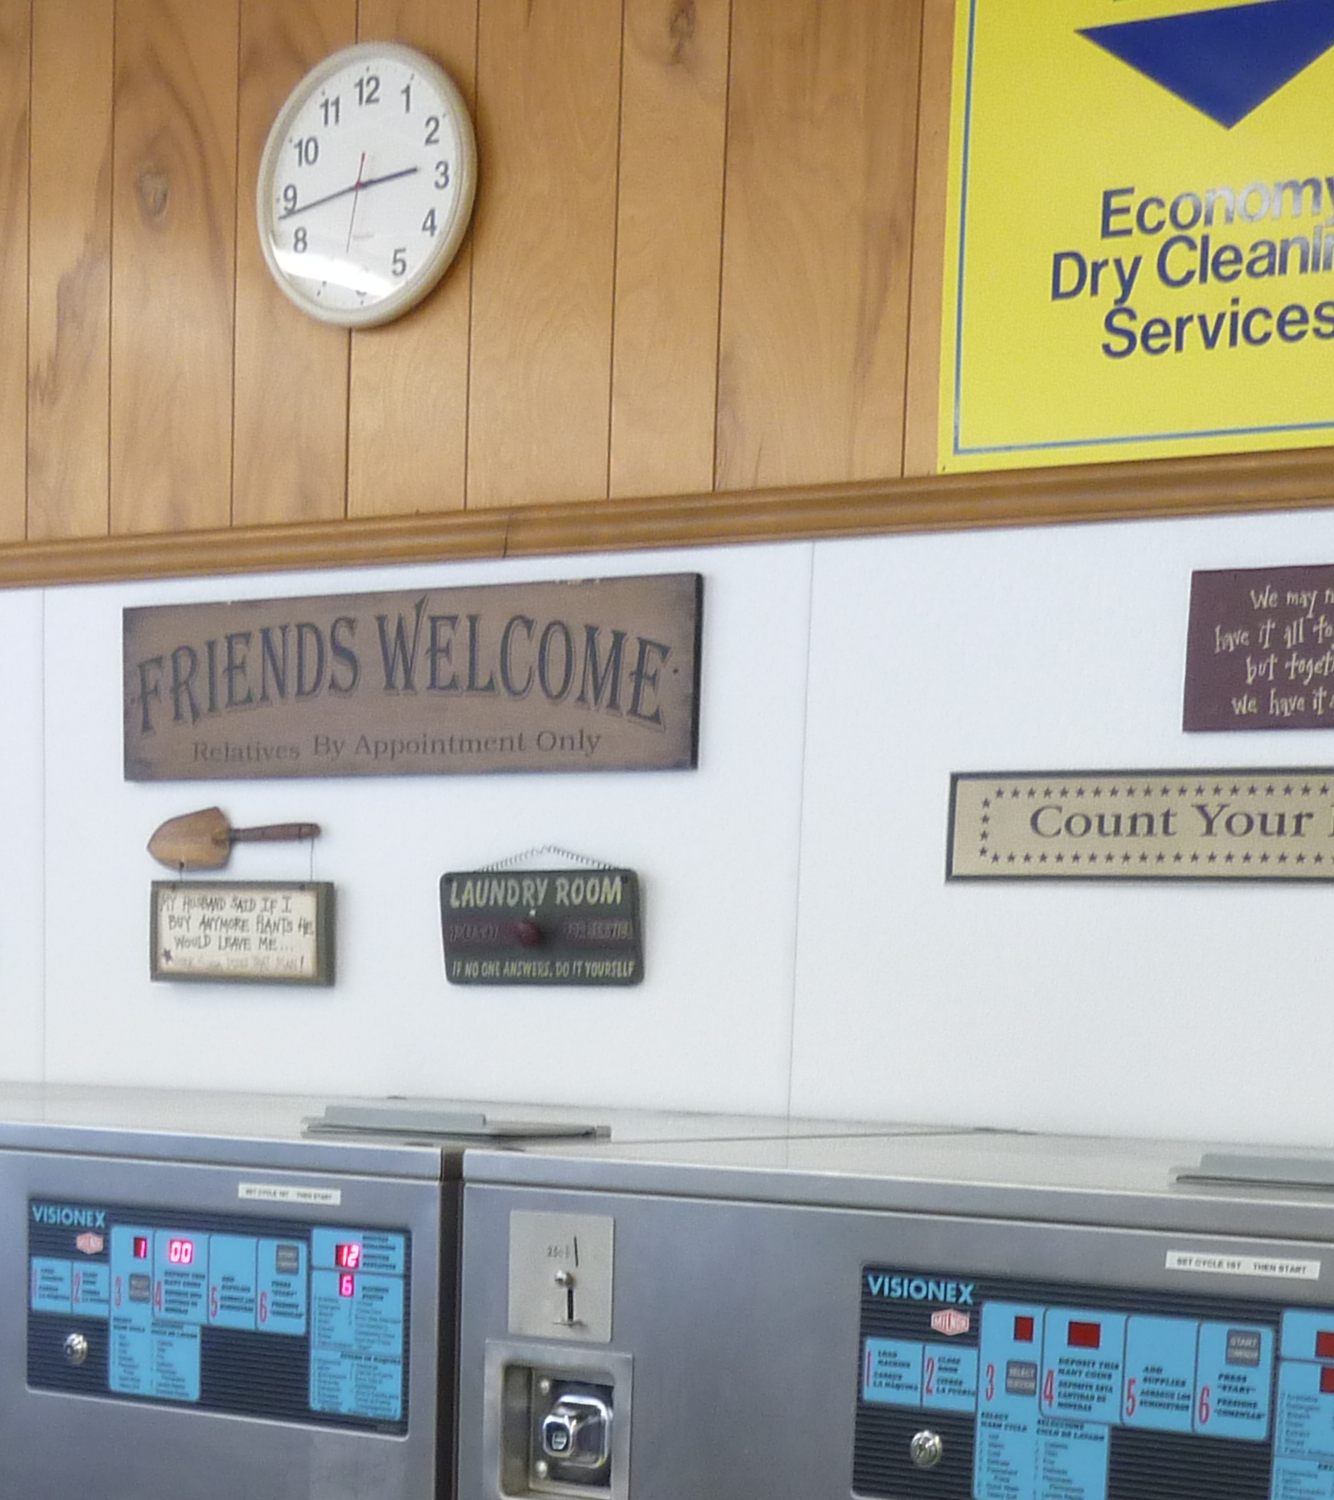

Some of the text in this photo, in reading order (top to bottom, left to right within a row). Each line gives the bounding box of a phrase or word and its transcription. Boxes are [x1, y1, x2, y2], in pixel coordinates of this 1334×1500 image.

[354, 75, 381, 106] 12
[401, 84, 411, 113] 1
[320, 96, 340, 127] 11
[425, 116, 440, 145] 2
[294, 136, 318, 167] 10
[434, 160, 450, 189] 3
[283, 184, 297, 214] 9
[422, 208, 437, 237] 4
[293, 226, 308, 253] 8
[392, 248, 407, 276] 5
[1051, 250, 1142, 306] Dry
[1250, 584, 1278, 609] We
[1287, 590, 1317, 619] may
[1214, 625, 1249, 654] have
[1258, 619, 1276, 650] it
[1284, 617, 1304, 649] all
[136, 595, 672, 734] FRIENDS WELCOME
[1246, 653, 1277, 685] but
[1269, 688, 1305, 717] have
[1313, 686, 1327, 715] it
[193, 729, 600, 764] Relatives By Appointment Only
[1030, 803, 1178, 839] Count
[1191, 803, 1315, 839] Your
[230, 896, 256, 913] SAID
[450, 876, 622, 908] LAUNDRY ROOM
[168, 915, 192, 931] BUY
[199, 915, 250, 933] ANYMORE
[174, 935, 211, 949] WOULD
[218, 936, 251, 951] LEAVE
[584, 960, 635, 977] YOURSELF
[32, 1205, 106, 1228] VISIONEX
[170, 1241, 193, 1263] 00
[341, 1244, 359, 1268] 12
[1195, 1259, 1223, 1268] CYCLE
[1253, 1262, 1277, 1272] THEN
[1279, 1264, 1306, 1274] START
[342, 1275, 353, 1297] 6
[868, 1275, 974, 1305] VISIONEX
[260, 1291, 267, 1323] 6
[926, 1357, 934, 1395] 2
[985, 1363, 994, 1402] 3
[1043, 1369, 1054, 1409] 4
[1126, 1377, 1136, 1417] 5
[1199, 1385, 1210, 1424] 6
